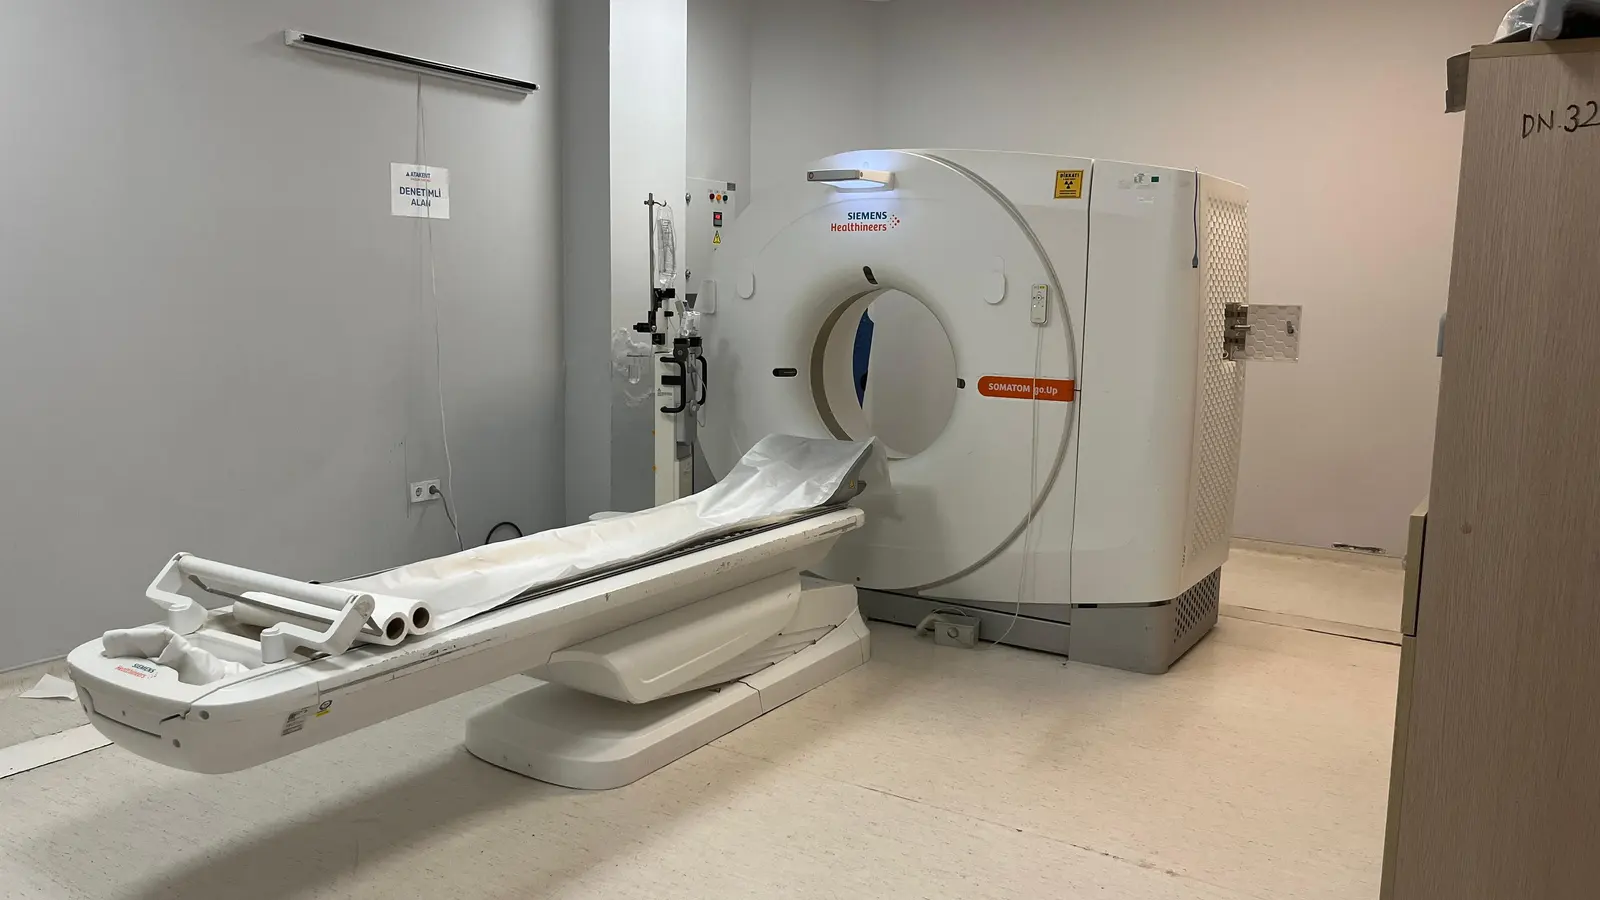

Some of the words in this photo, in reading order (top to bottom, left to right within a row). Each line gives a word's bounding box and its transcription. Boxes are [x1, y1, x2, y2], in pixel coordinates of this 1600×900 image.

[411, 198, 431, 207] ALAN
[847, 211, 887, 220] SIEMENS
[830, 222, 887, 232] Healthineers
[988, 383, 1030, 393] SOMATOM
[1034, 386, 1058, 396] go.Up
